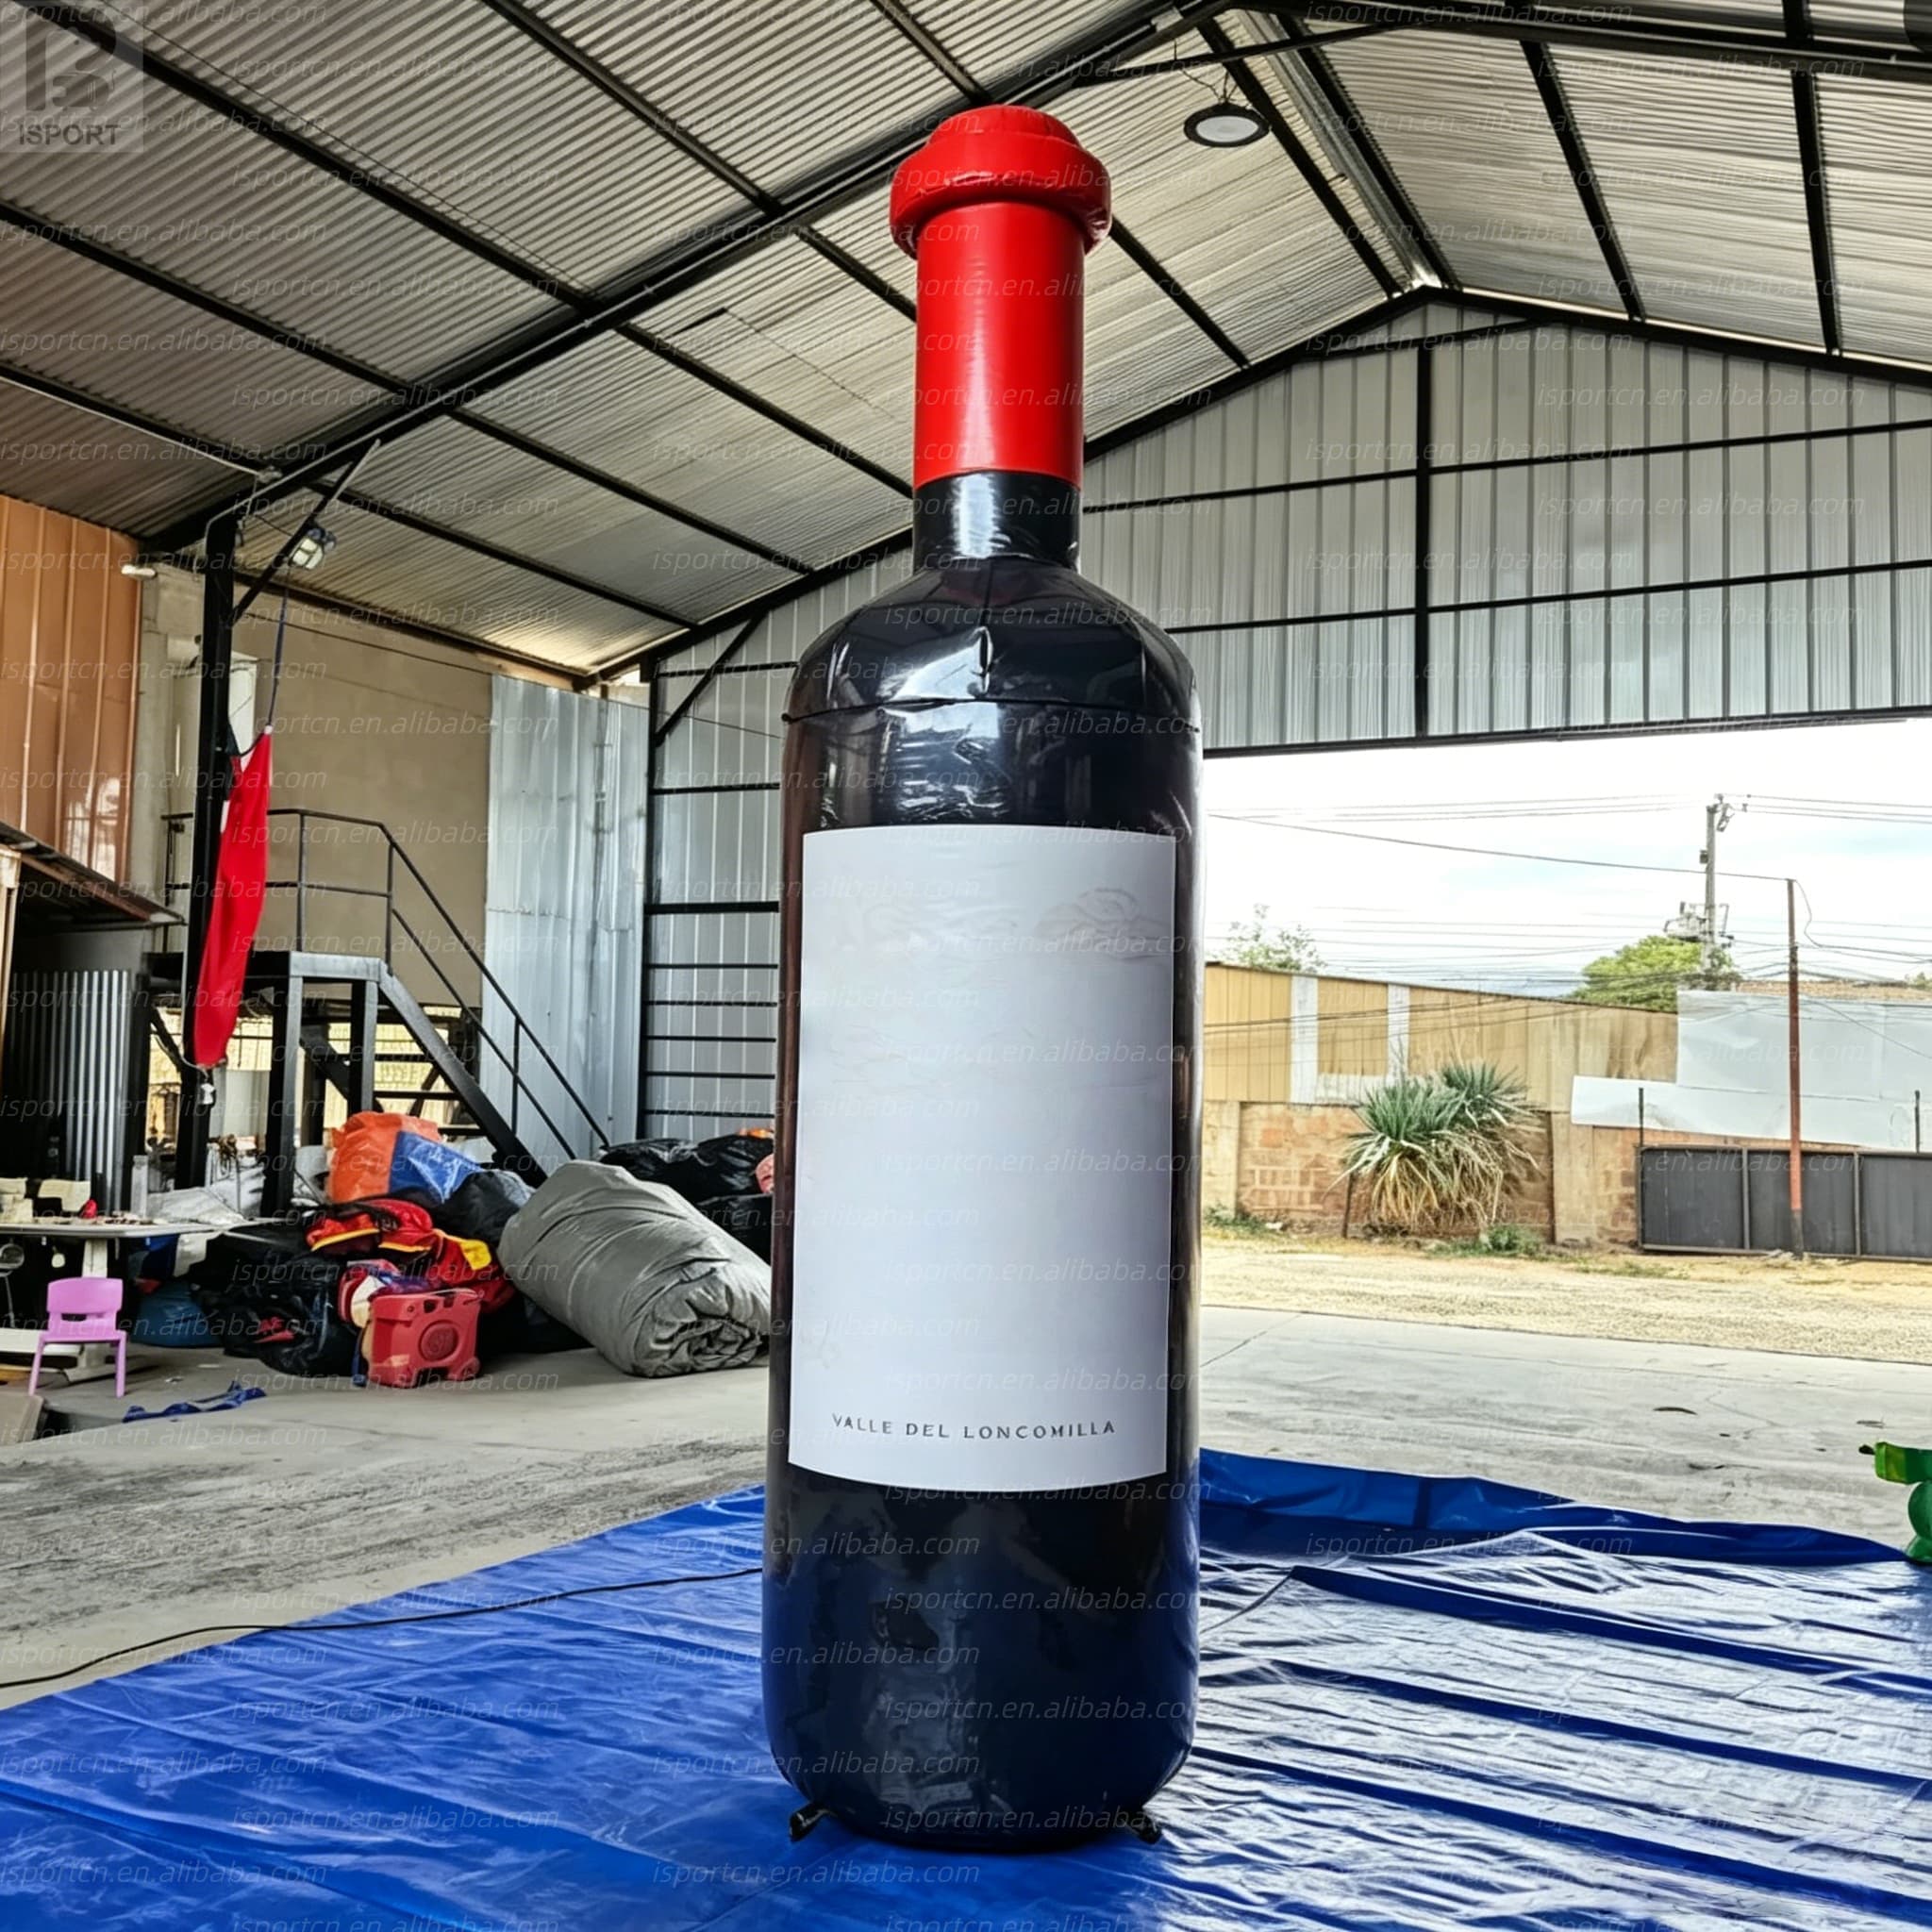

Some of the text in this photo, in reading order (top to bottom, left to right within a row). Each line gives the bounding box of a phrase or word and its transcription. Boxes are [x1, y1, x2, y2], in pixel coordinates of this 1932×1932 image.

[831, 1413, 1115, 1441] VALLE DEL LONCOMILLA
